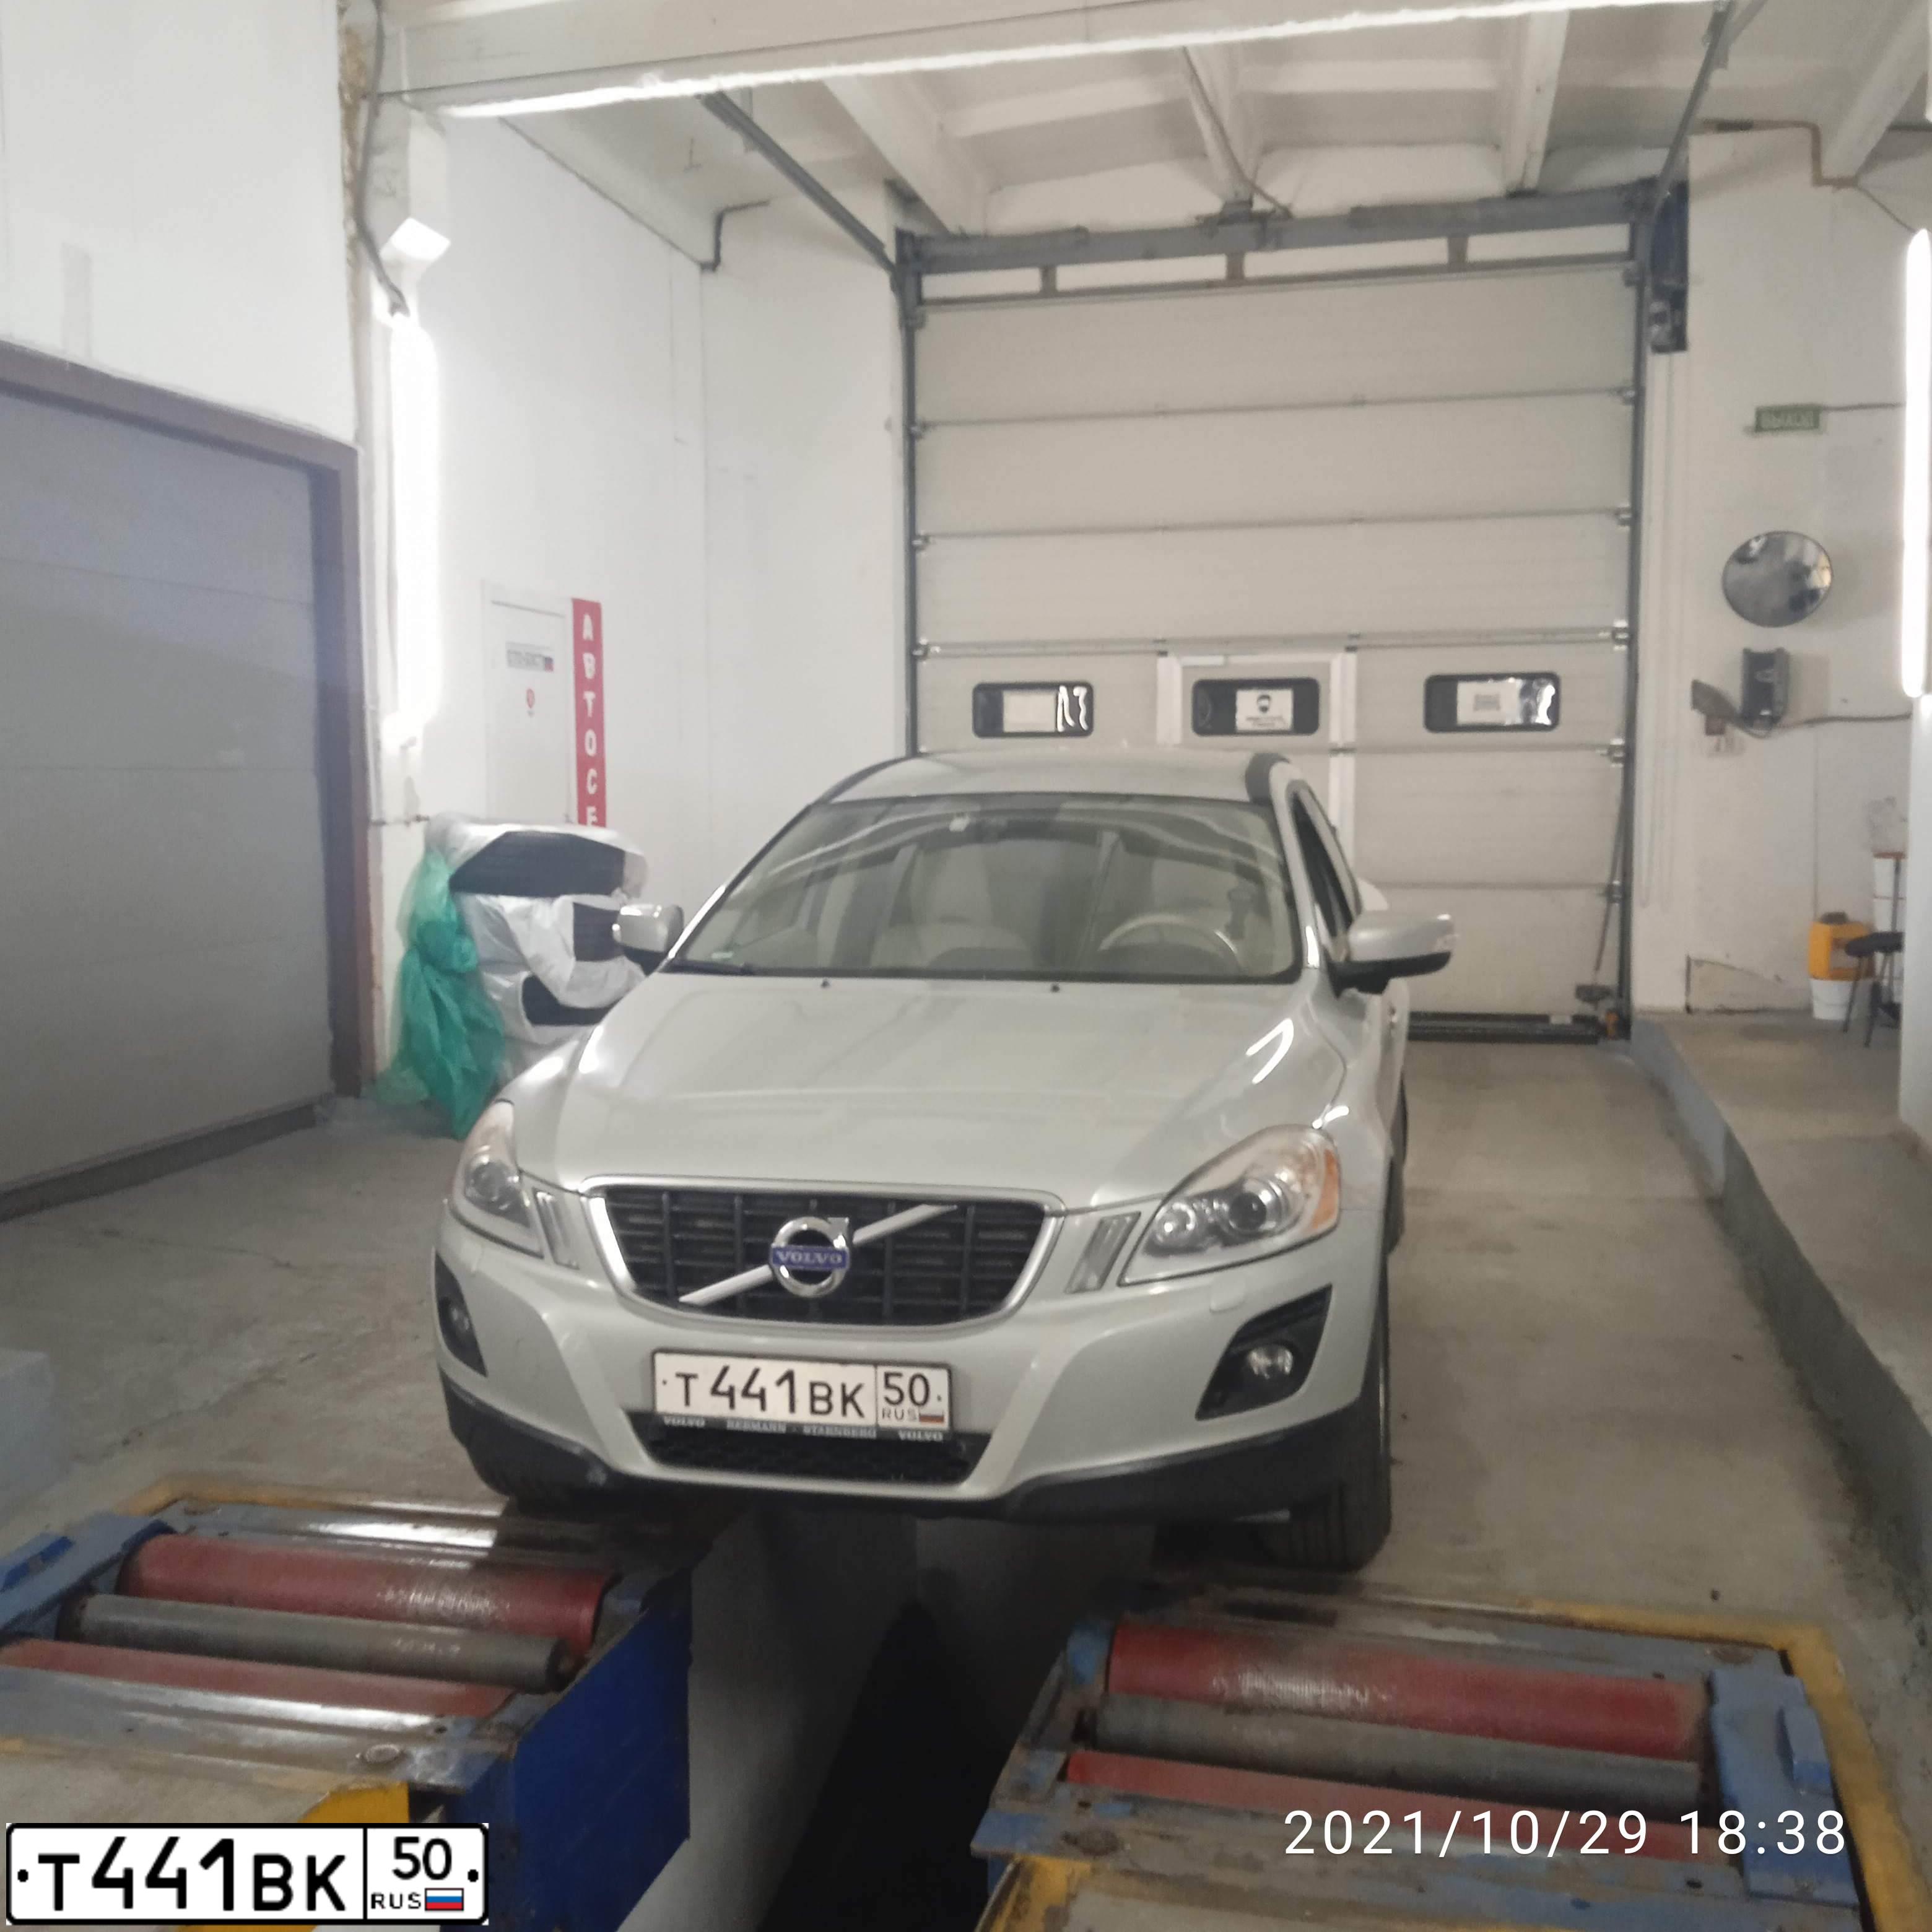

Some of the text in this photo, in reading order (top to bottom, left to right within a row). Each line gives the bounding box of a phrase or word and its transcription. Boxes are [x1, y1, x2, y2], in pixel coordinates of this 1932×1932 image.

[776, 1250, 843, 1264] VOLVO
[883, 1371, 930, 1408] 50
[881, 1408, 918, 1421] RUS
[664, 1416, 705, 1428] VOLVO
[899, 1429, 943, 1442] VOLVO
